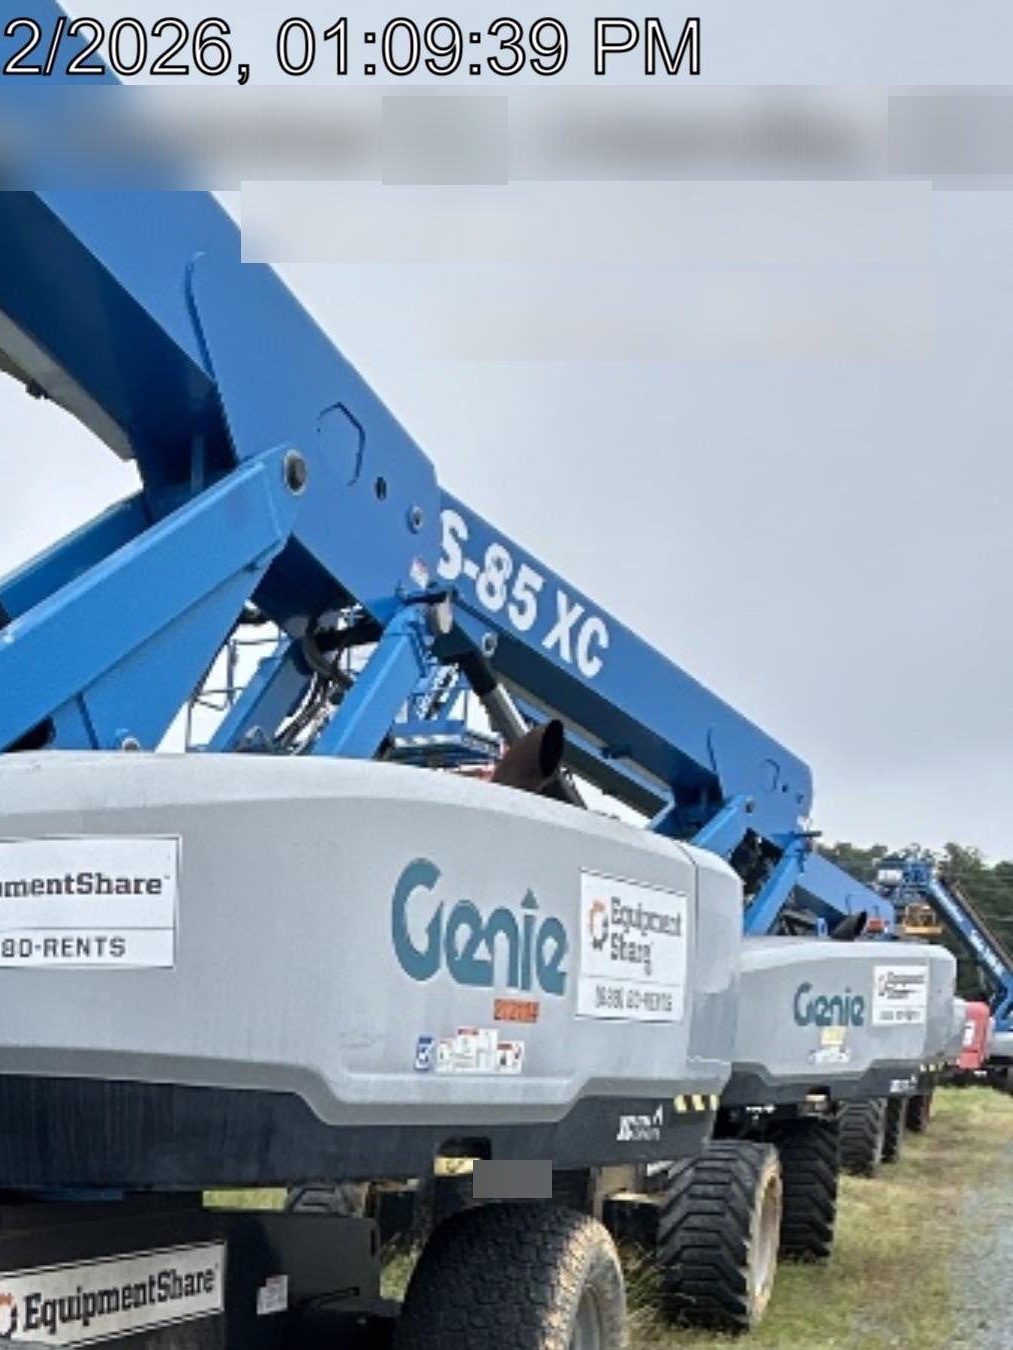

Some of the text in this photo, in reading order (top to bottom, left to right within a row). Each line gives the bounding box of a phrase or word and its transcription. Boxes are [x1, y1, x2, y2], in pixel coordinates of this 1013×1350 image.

[437, 509, 609, 678] S-85 XC
[391, 857, 568, 997] Genie
[610, 896, 682, 937] Equipment
[794, 980, 865, 1026] Genie
[22, 1269, 215, 1334] EquipmentShare
